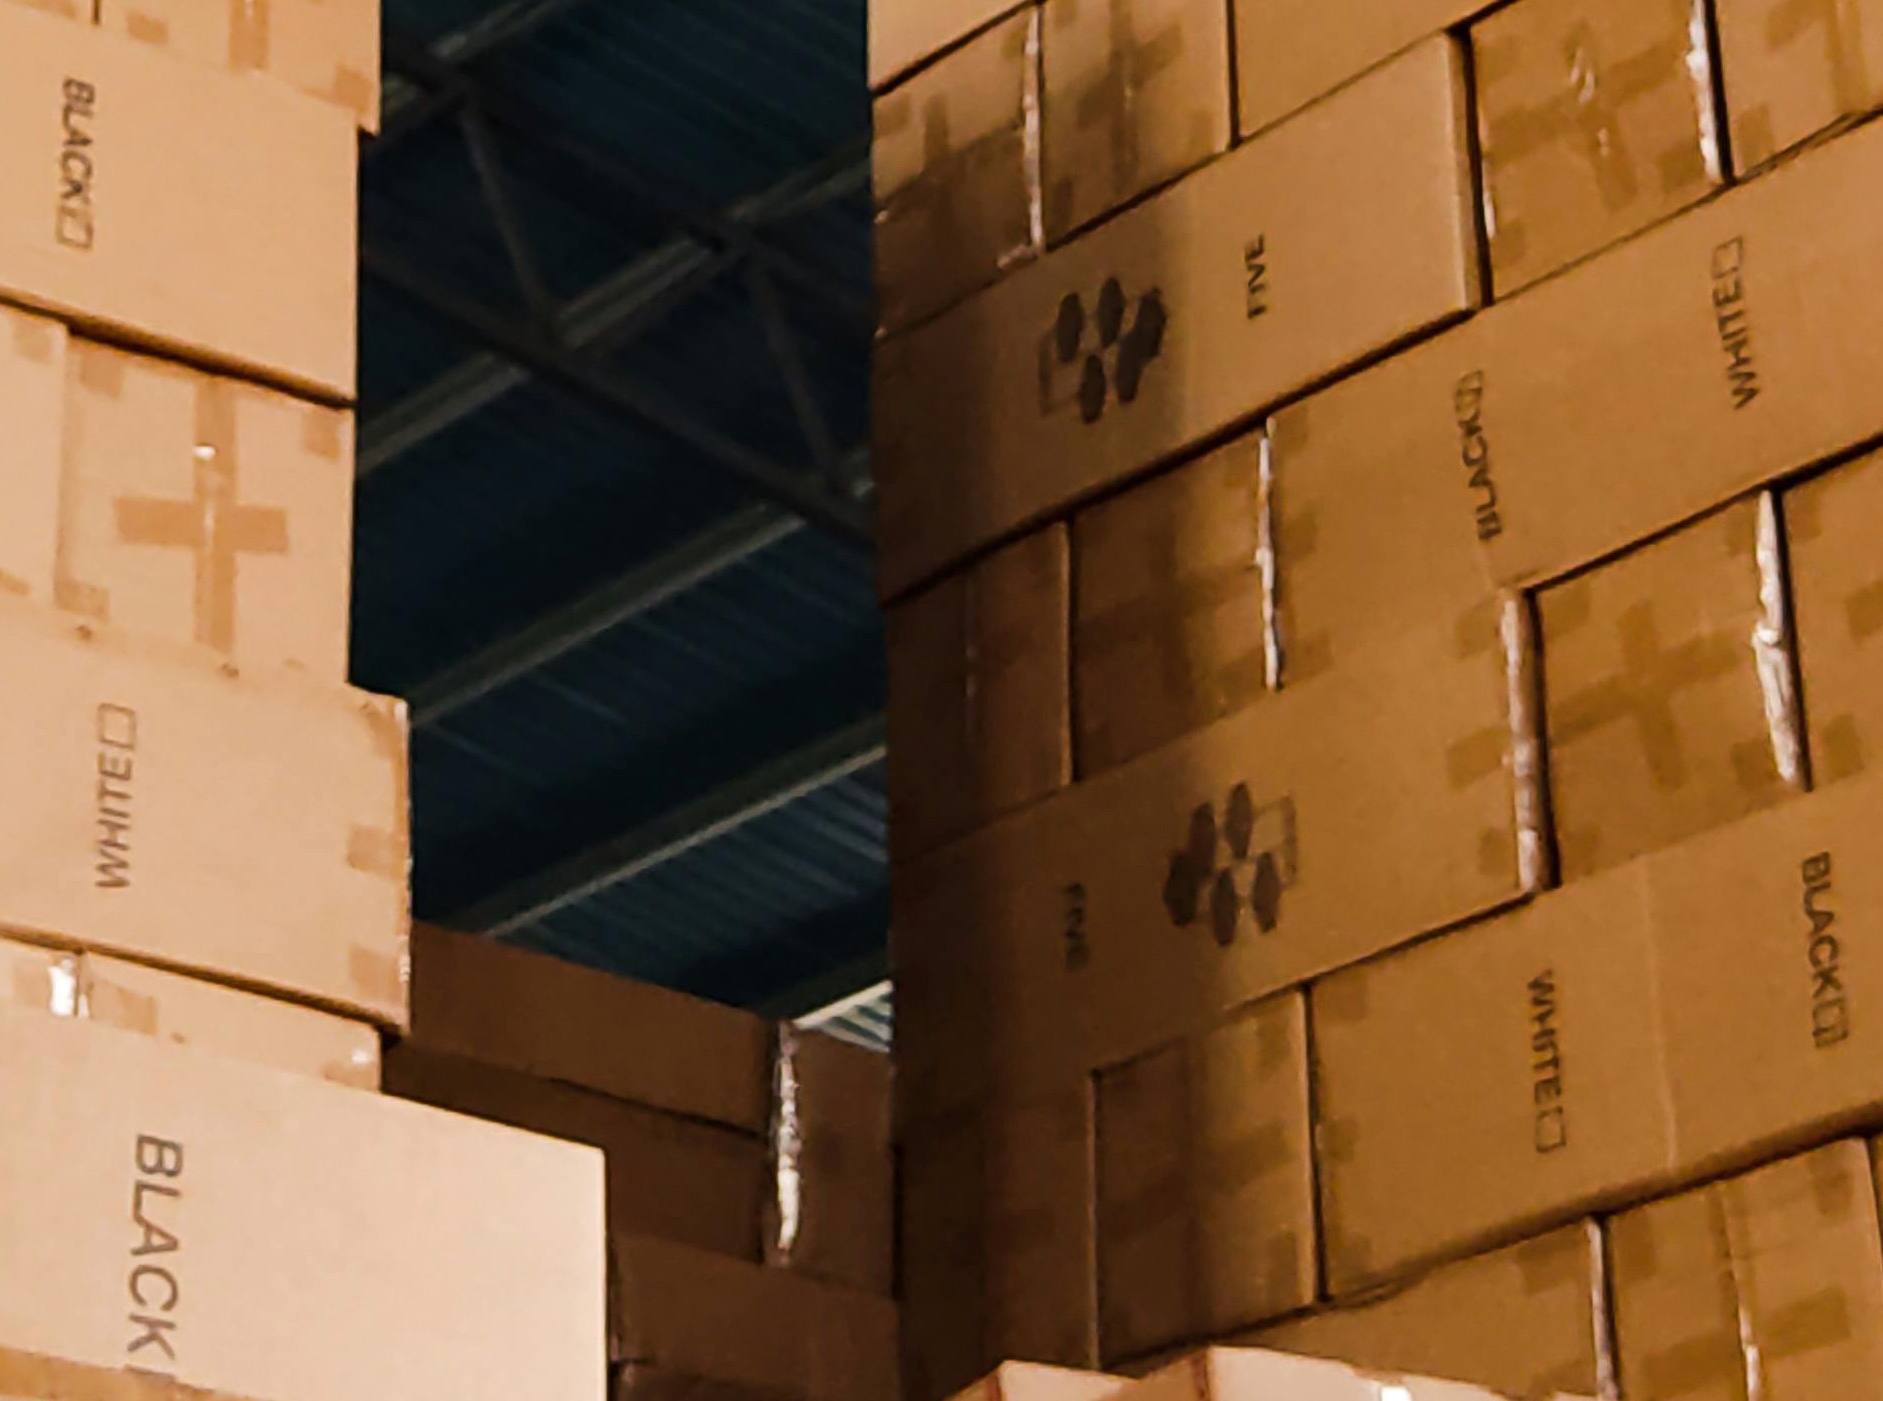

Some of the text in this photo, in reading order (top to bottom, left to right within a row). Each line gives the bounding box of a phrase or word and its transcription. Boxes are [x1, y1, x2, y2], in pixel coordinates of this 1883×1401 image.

[60, 78, 95, 206] BLACK
[1245, 235, 1267, 320] FIVE
[1713, 279, 1761, 411] WHITE
[1458, 412, 1503, 542] BLACK
[95, 753, 132, 889] WHITE
[1802, 852, 1843, 997] BLACK
[1527, 969, 1563, 1104] WHITE
[127, 1134, 183, 1358] BLACK
